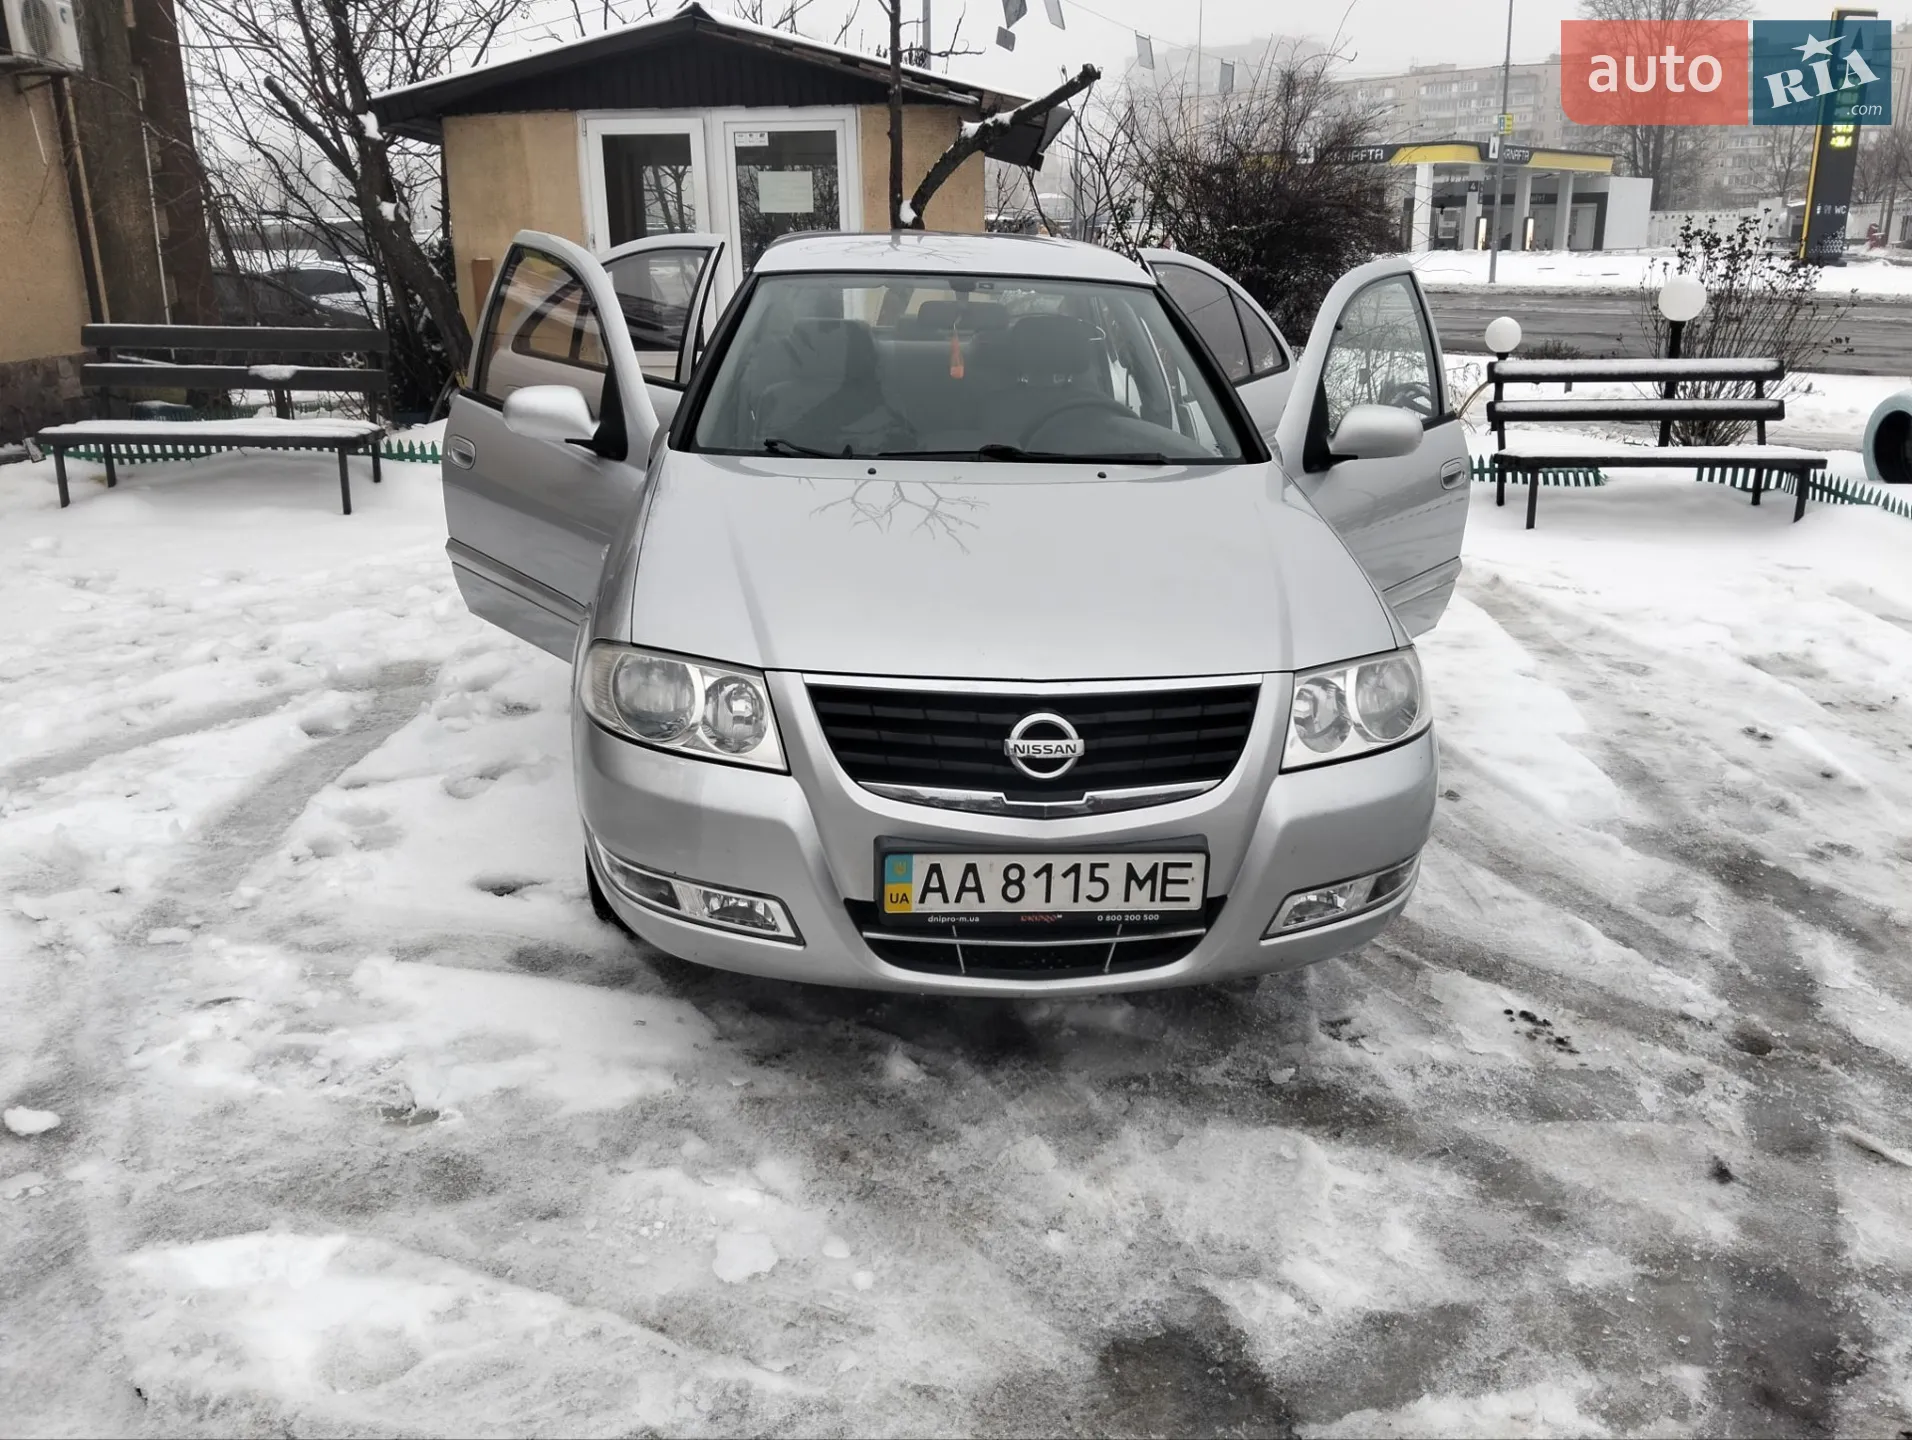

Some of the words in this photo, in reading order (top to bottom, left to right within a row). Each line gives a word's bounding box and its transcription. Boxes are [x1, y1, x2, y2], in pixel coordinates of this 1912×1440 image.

[1834, 205, 1847, 214] WC
[1013, 743, 1077, 755] NISSAN
[918, 862, 985, 904] AA
[1001, 861, 1110, 903] 8115
[1123, 861, 1193, 903] ME
[889, 892, 910, 905] UA
[927, 914, 980, 924] dnipro-m.ua
[1105, 914, 1122, 922] 800
[1124, 914, 1141, 922] 200
